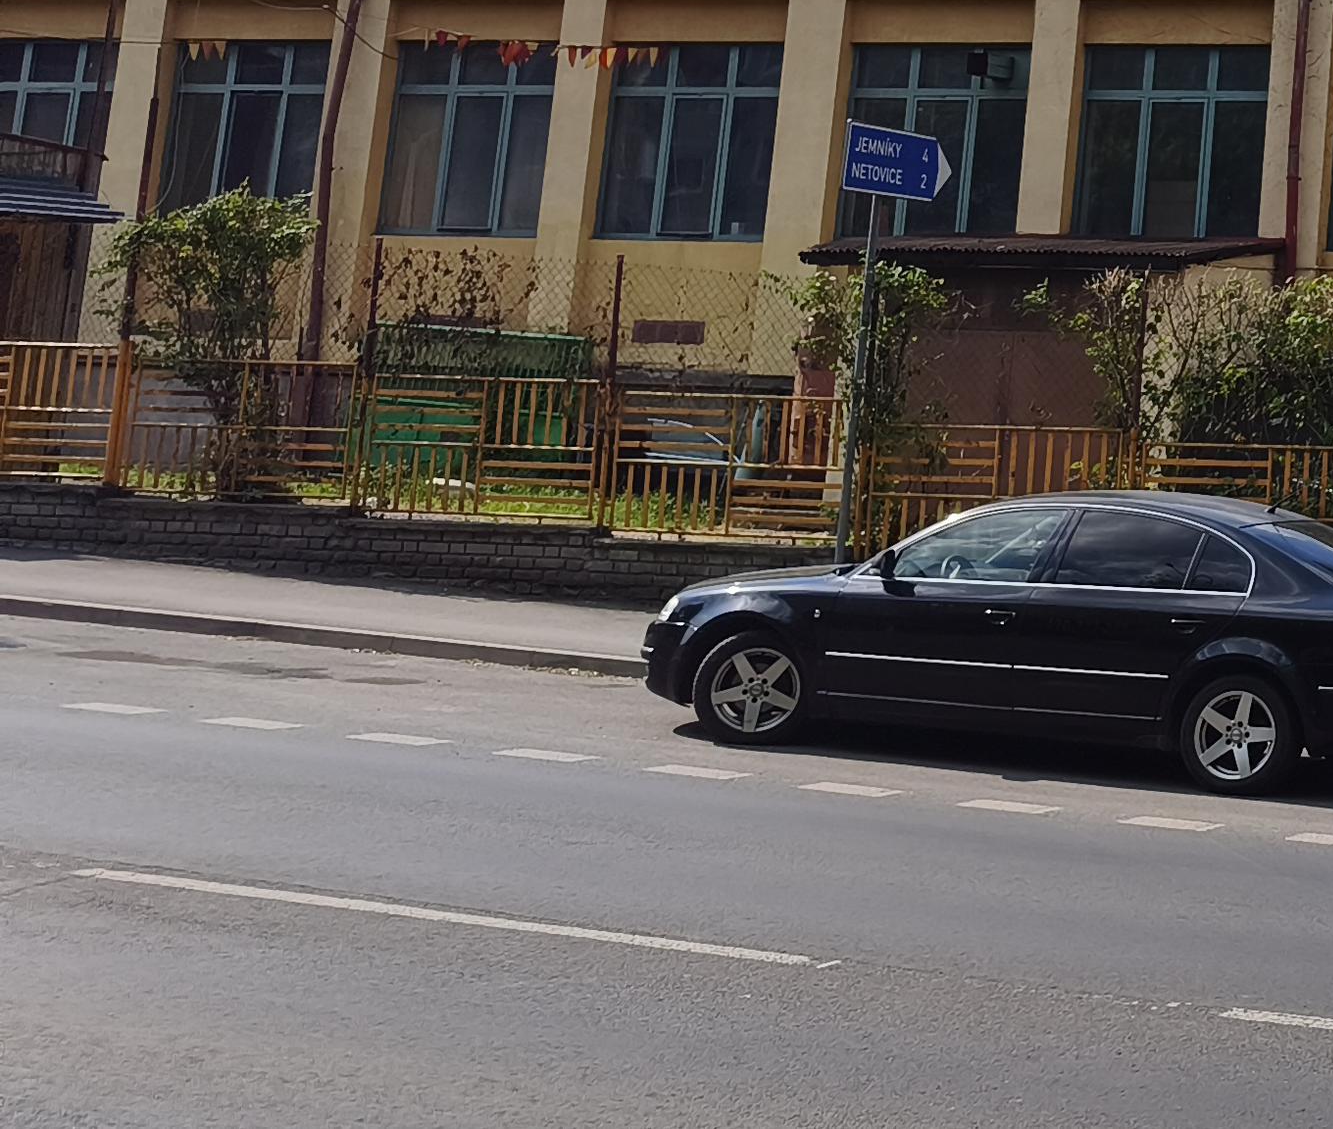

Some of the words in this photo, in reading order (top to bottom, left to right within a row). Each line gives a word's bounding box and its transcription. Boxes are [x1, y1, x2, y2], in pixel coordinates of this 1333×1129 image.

[855, 136, 902, 158] JEMNÍKY
[922, 148, 929, 163] 4
[851, 162, 903, 185] NETOVICE
[920, 174, 927, 189] 2
